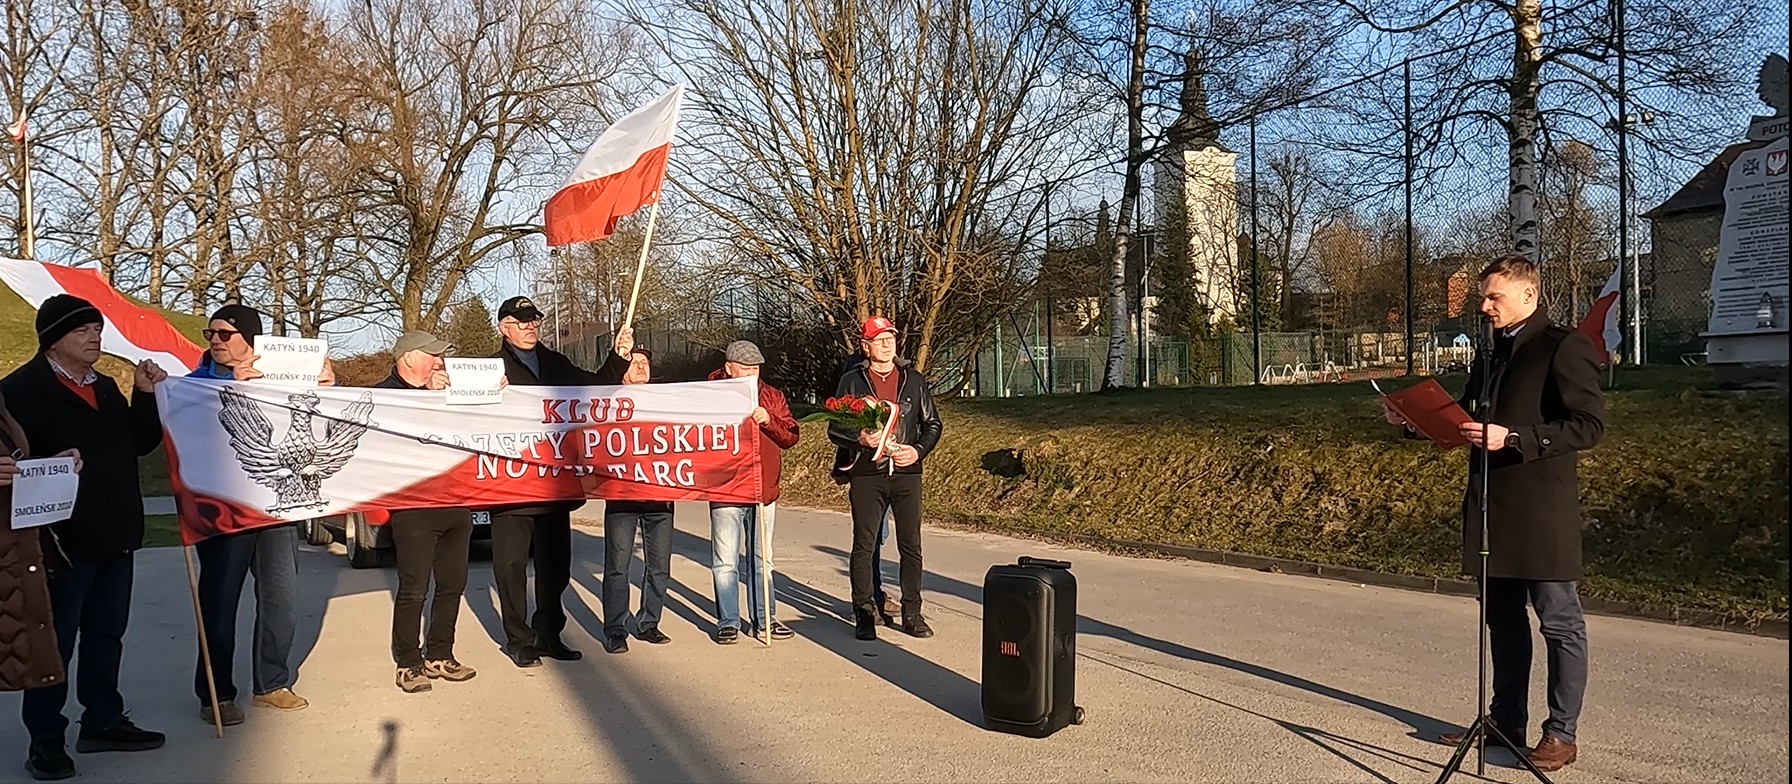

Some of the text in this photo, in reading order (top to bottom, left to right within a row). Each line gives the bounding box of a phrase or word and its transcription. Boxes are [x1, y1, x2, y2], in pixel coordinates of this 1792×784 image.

[263, 342, 320, 353] KATYŃ 1940
[452, 361, 498, 371] KATYŃ 1940
[262, 372, 301, 381] MOLEŃSK
[449, 388, 485, 396] SMOLEŃSK
[541, 397, 635, 423] KLUB
[582, 422, 743, 459] POLSKIEJ
[20, 463, 69, 478] KATYŃ 1940
[607, 458, 696, 487] TARG
[14, 502, 56, 517] SMOLEŃSK
[1001, 640, 1020, 657] JBL
